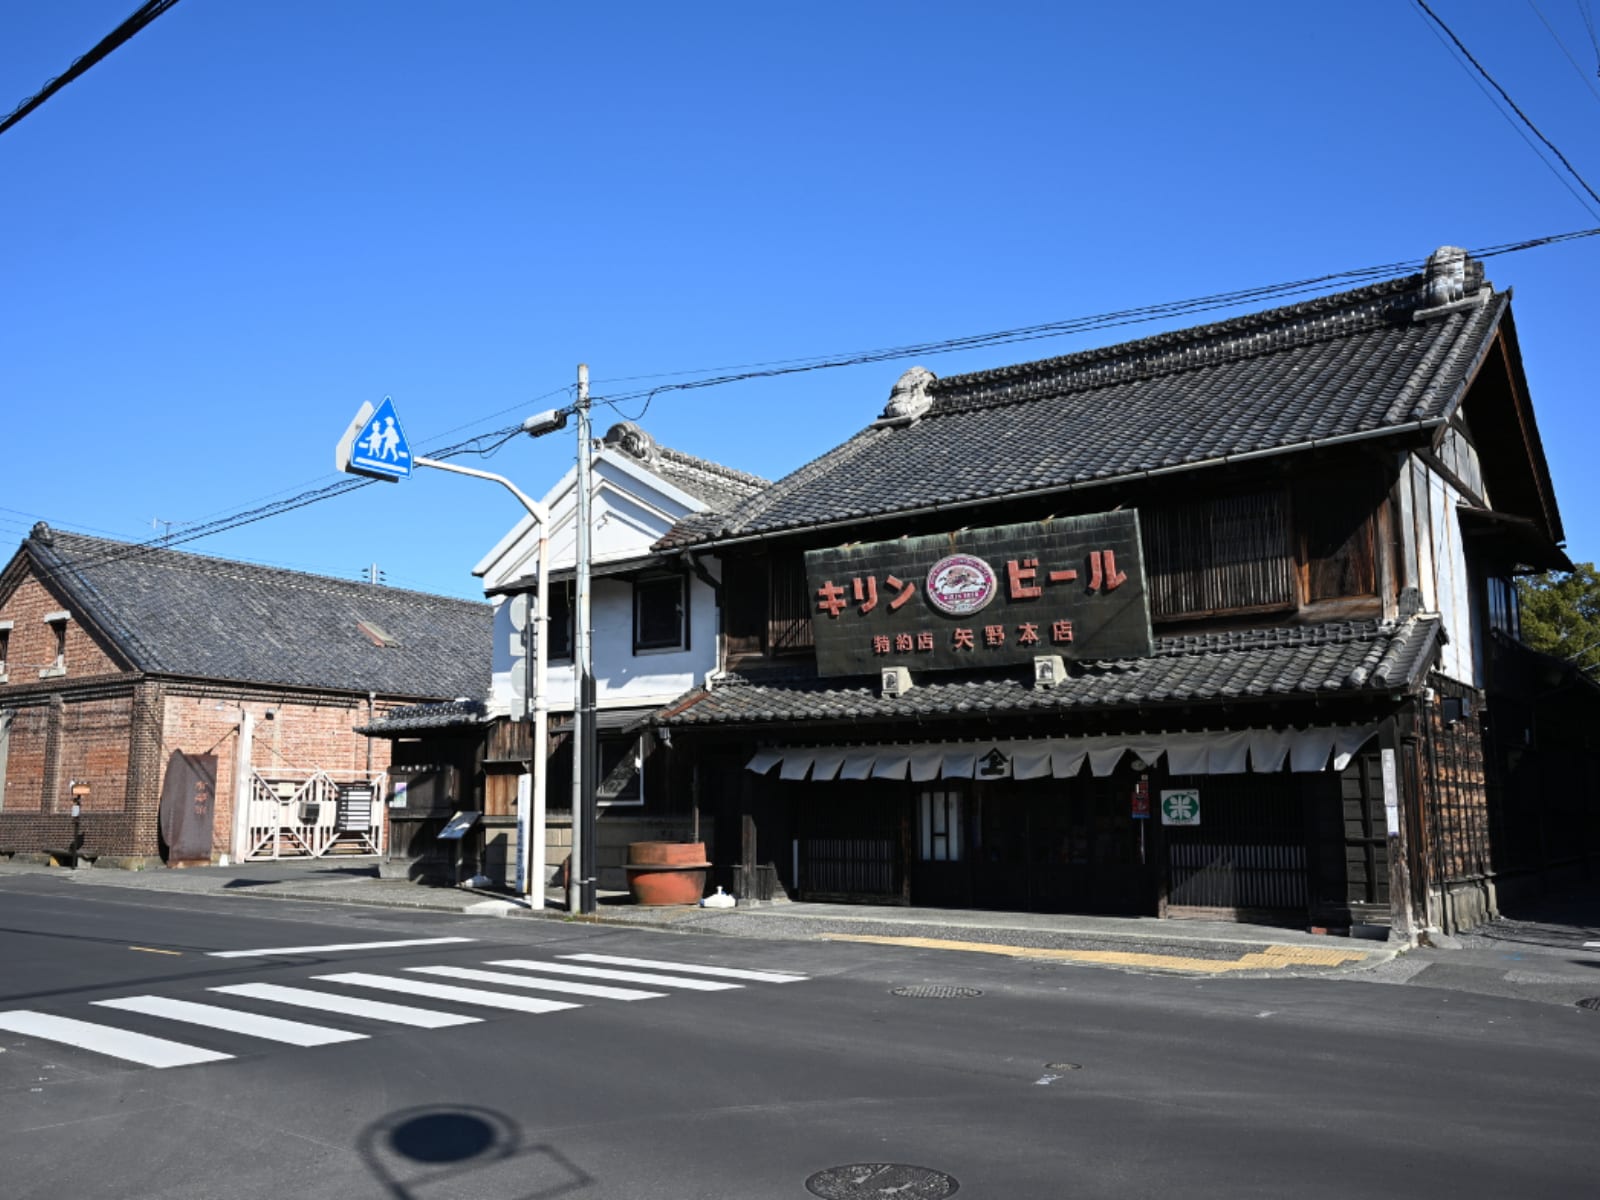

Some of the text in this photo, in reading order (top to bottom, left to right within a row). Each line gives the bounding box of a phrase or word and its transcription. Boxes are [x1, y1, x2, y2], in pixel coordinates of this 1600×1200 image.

[818, 574, 917, 616] キリン
[1007, 549, 1127, 599] ビール
[873, 619, 1074, 653] 特約店 矢野本店
